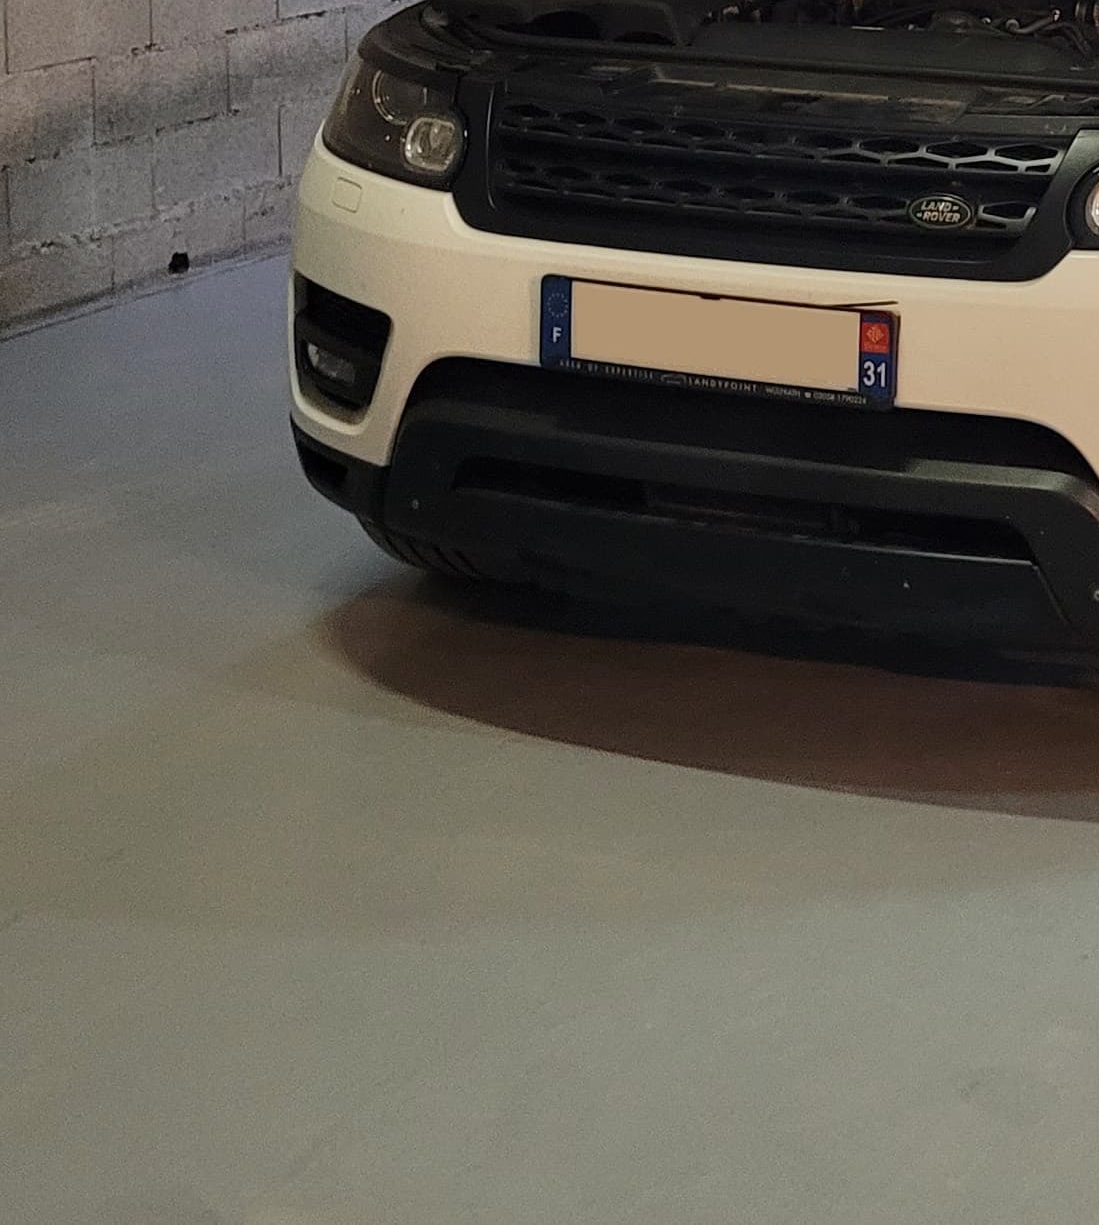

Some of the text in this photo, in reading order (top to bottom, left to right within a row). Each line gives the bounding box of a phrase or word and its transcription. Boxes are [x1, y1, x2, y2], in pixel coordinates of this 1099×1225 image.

[921, 201, 952, 212] LAND
[922, 211, 961, 223] ROVER
[552, 326, 562, 343] F
[863, 360, 886, 388] 31
